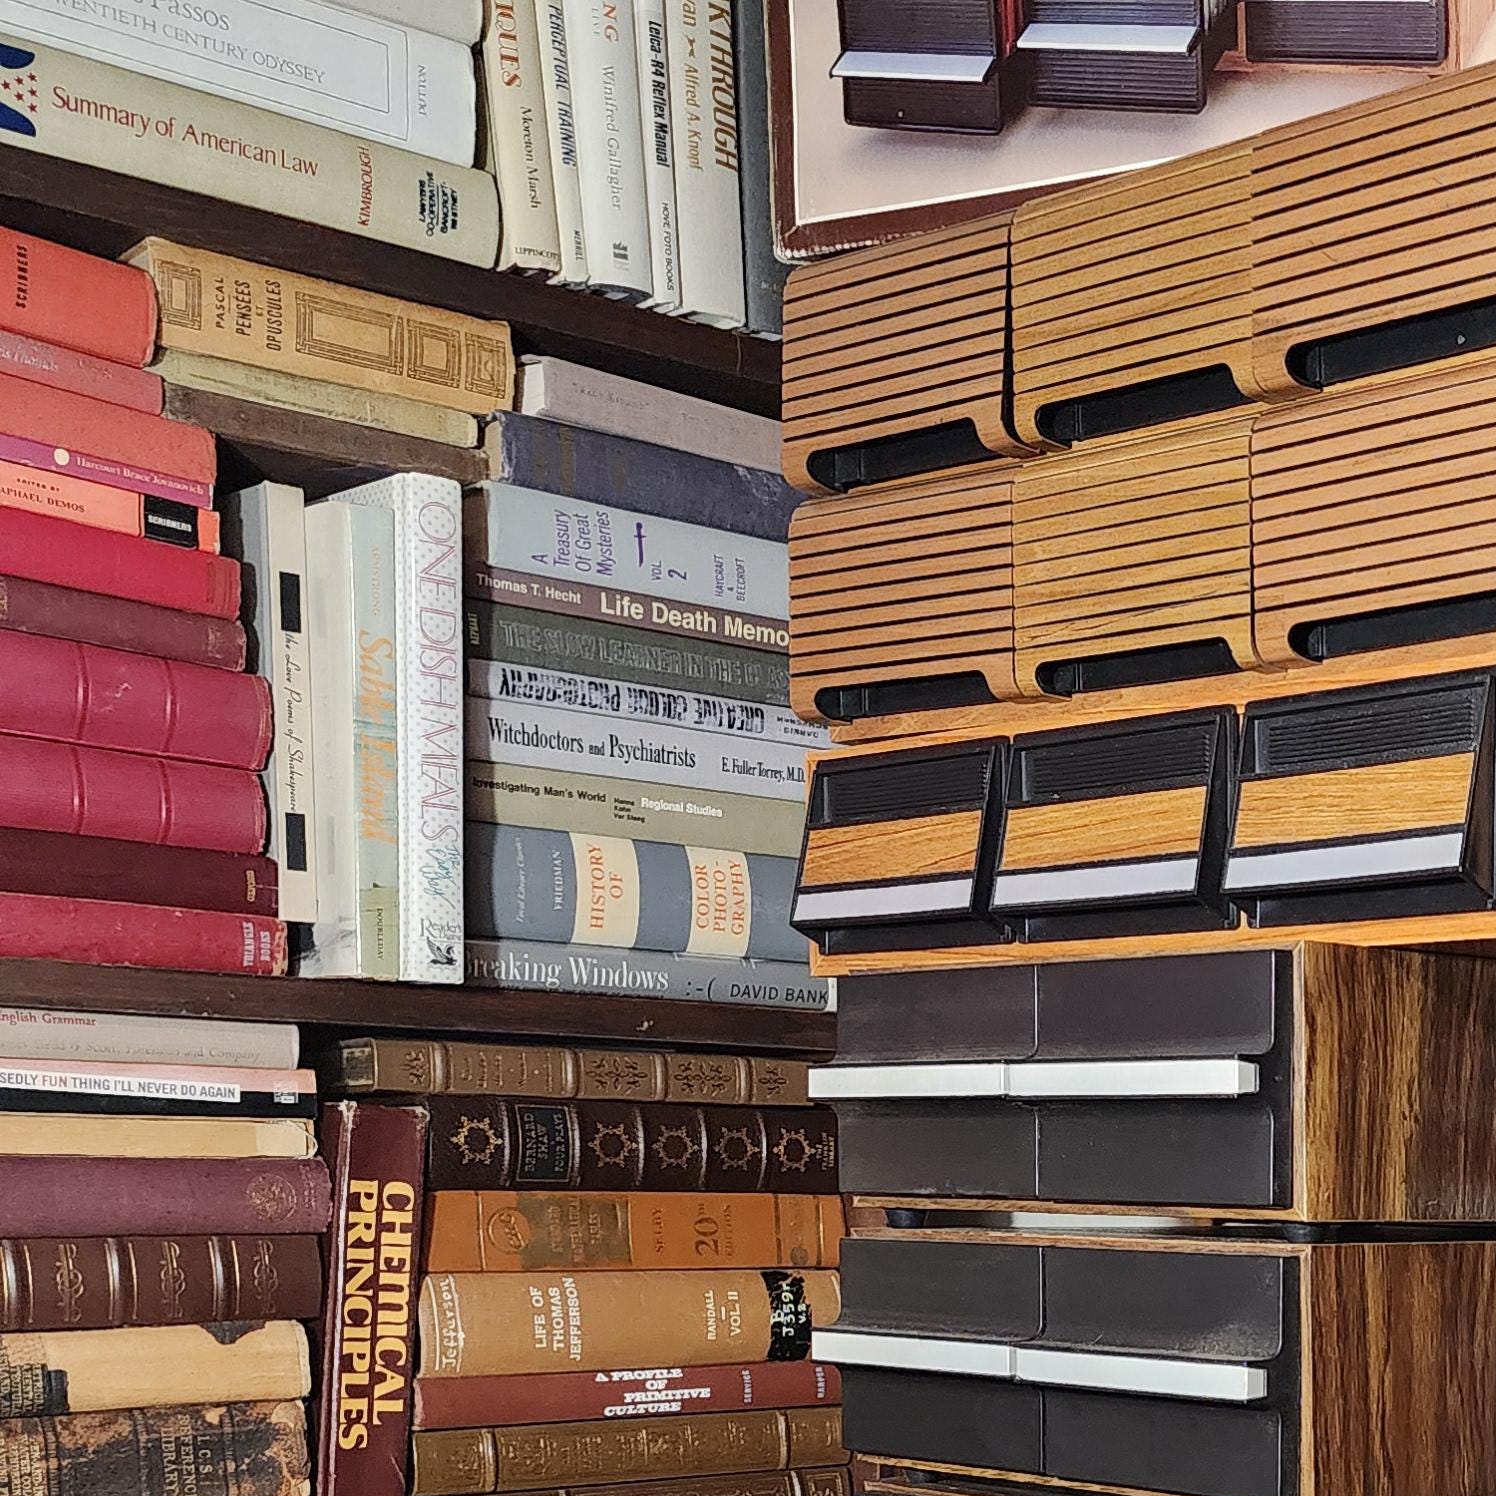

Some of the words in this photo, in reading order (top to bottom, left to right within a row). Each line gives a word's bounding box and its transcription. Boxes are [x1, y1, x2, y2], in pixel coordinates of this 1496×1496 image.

[548, 4, 570, 90] PERCEPTUAL
[602, 64, 619, 133] Winifred
[53, 86, 150, 138] Summary
[155, 117, 175, 139] of
[182, 123, 276, 165] American
[281, 150, 319, 177] Law
[520, 106, 535, 162] Moreton
[557, 100, 577, 167] TRAINING
[357, 146, 373, 226] KIMBROUGH
[527, 165, 542, 209] Marsh
[605, 137, 623, 210] Gallagher
[215, 277, 225, 329] PASCAL
[234, 280, 251, 336] PENSÉES
[265, 280, 283, 351] OPUSCULES
[418, 501, 456, 599] ONE
[553, 508, 572, 568] Treasury
[574, 512, 590, 550] Great
[596, 511, 613, 576] Mysteries
[574, 551, 590, 573] Of
[714, 553, 724, 598] HAYCRAFT
[476, 573, 527, 594] Thomas
[530, 583, 541, 597] T.
[544, 586, 582, 604] Hecht
[600, 591, 644, 620] Life
[652, 601, 717, 634] Death
[419, 606, 457, 710] DISH
[487, 716, 584, 753] Witchdoctors
[588, 740, 605, 756] and
[608, 733, 697, 769] Psychiatrists
[692, 696, 766, 734] CREATIVE
[421, 715, 459, 843] MEALS
[472, 776, 540, 797] Investigating
[543, 786, 573, 799] Man's
[576, 788, 606, 803] World
[641, 797, 684, 814] Regional
[686, 802, 723, 818] Studies
[553, 848, 563, 911] FRIEDMAN
[590, 843, 606, 930] HISTORY
[610, 871, 624, 899] OF
[696, 863, 709, 929] COLOR
[731, 859, 744, 936] GRAPHY
[375, 907, 384, 961] DOUBLEDAY
[567, 955, 669, 990] Windows
[42, 1075, 68, 1088] FUN
[71, 1076, 110, 1091] THING
[113, 1079, 135, 1093] I'LL
[137, 1082, 178, 1096] NEVER
[181, 1084, 198, 1096] DO
[200, 1085, 236, 1099] AGAIN
[523, 1111, 535, 1173] BERNARD
[338, 1179, 381, 1451] PRINCIPLES
[374, 1181, 415, 1425] CHEMICAL
[528, 1286, 544, 1311] OF
[548, 1285, 566, 1351] THOMAS
[562, 1277, 582, 1362] JEFFERSON
[705, 1289, 716, 1341] RANDALL
[533, 1314, 549, 1350] LIFE
[603, 1402, 682, 1417] CULTURE
[623, 1387, 711, 1402] PRIMITIVE
[645, 1379, 667, 1390] OF
